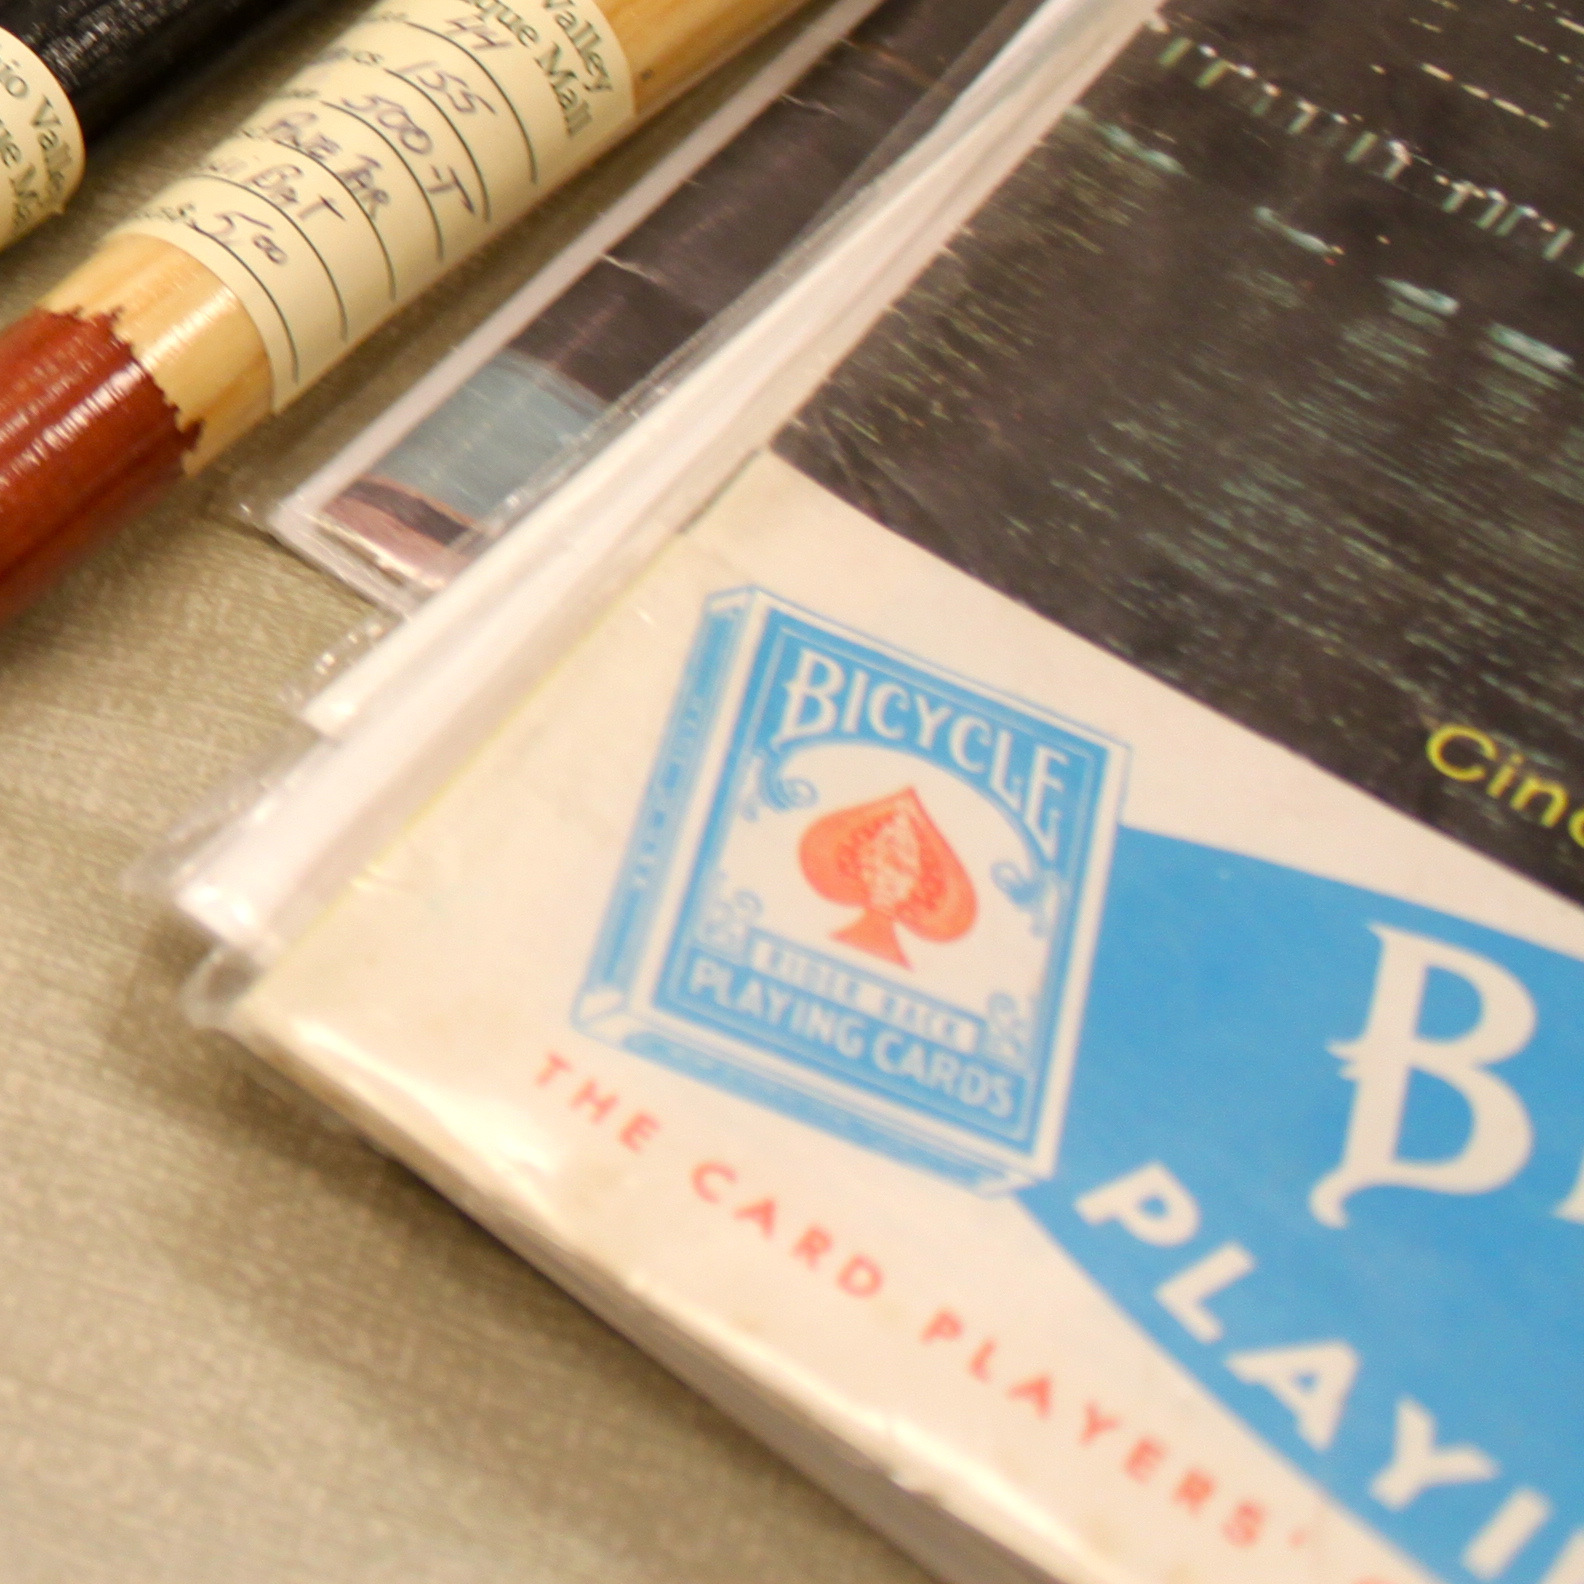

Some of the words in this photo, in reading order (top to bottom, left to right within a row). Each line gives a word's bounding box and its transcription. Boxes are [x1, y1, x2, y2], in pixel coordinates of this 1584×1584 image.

[397, 61, 497, 117] 155
[444, 20, 512, 46] 44
[535, 44, 594, 139] Mall
[331, 153, 392, 222] TAR
[340, 95, 477, 214] 500-T
[774, 648, 1071, 861] BICYCLE
[688, 956, 867, 1059] PLAYING
[872, 1030, 1014, 1119] CARDS
[1308, 919, 1584, 1228] B
[533, 1052, 664, 1154] THE
[690, 1160, 886, 1301] CARD
[921, 1308, 1312, 1551] PLAYERS'
